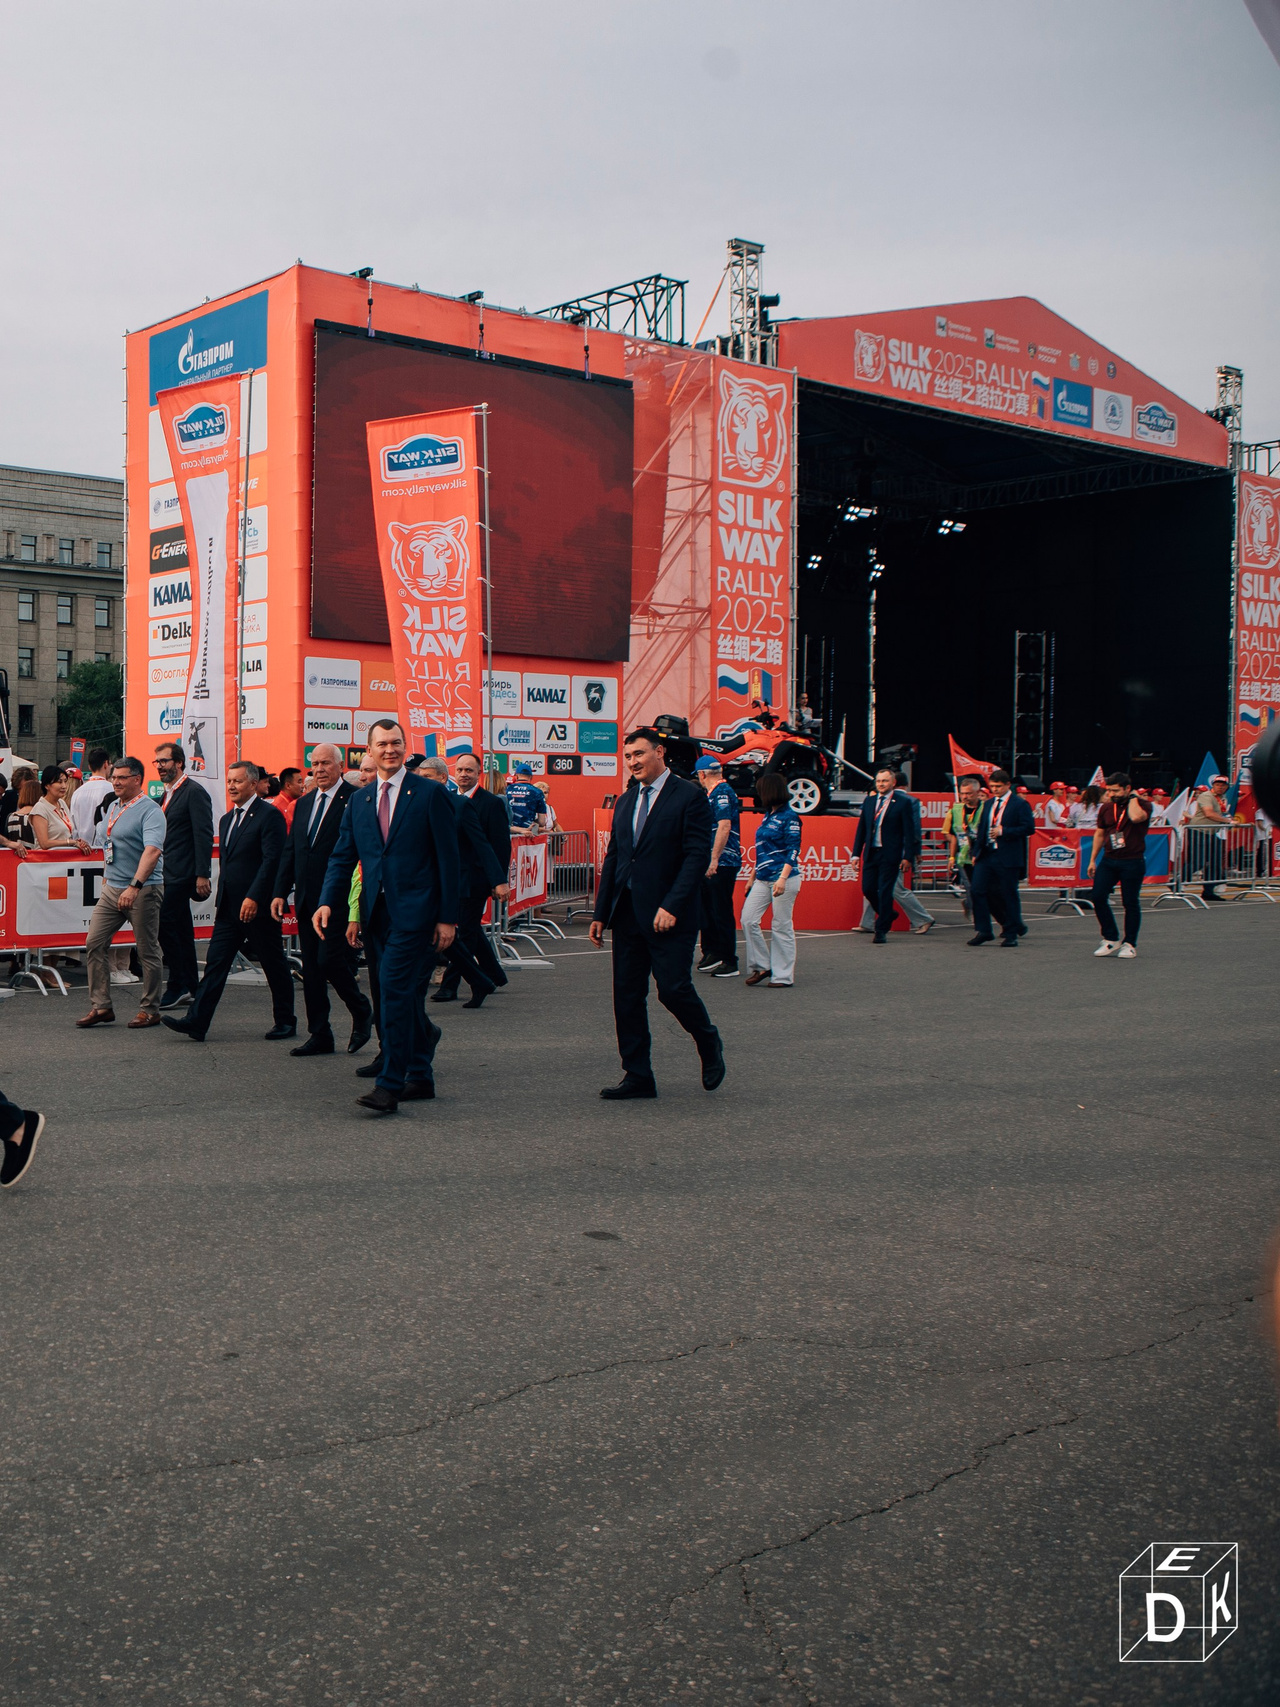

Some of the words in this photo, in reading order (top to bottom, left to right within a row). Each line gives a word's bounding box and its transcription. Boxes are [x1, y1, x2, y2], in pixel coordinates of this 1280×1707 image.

[194, 340, 234, 371] ГАЗПРОМ
[211, 363, 234, 378] ПАРТНЕР
[888, 338, 932, 370] SILK
[934, 349, 975, 380] 2025
[975, 359, 1030, 391] RALLY
[888, 363, 932, 395] WAY
[718, 490, 783, 532] SILK
[152, 540, 188, 560] G-ENER
[718, 526, 783, 567] WAY
[153, 581, 192, 607] KAMA
[717, 566, 783, 598] RALLY
[1241, 572, 1280, 602] SILK
[717, 595, 784, 636] 2025
[717, 633, 782, 665] 丝绸之路
[1240, 630, 1280, 652] RALLY
[1240, 651, 1280, 681] 2025
[321, 678, 357, 687] ГАЗПРОМБАНК
[527, 687, 566, 704] KAMAZ
[308, 721, 349, 730] MONGOLIA
[555, 759, 573, 770] 360
